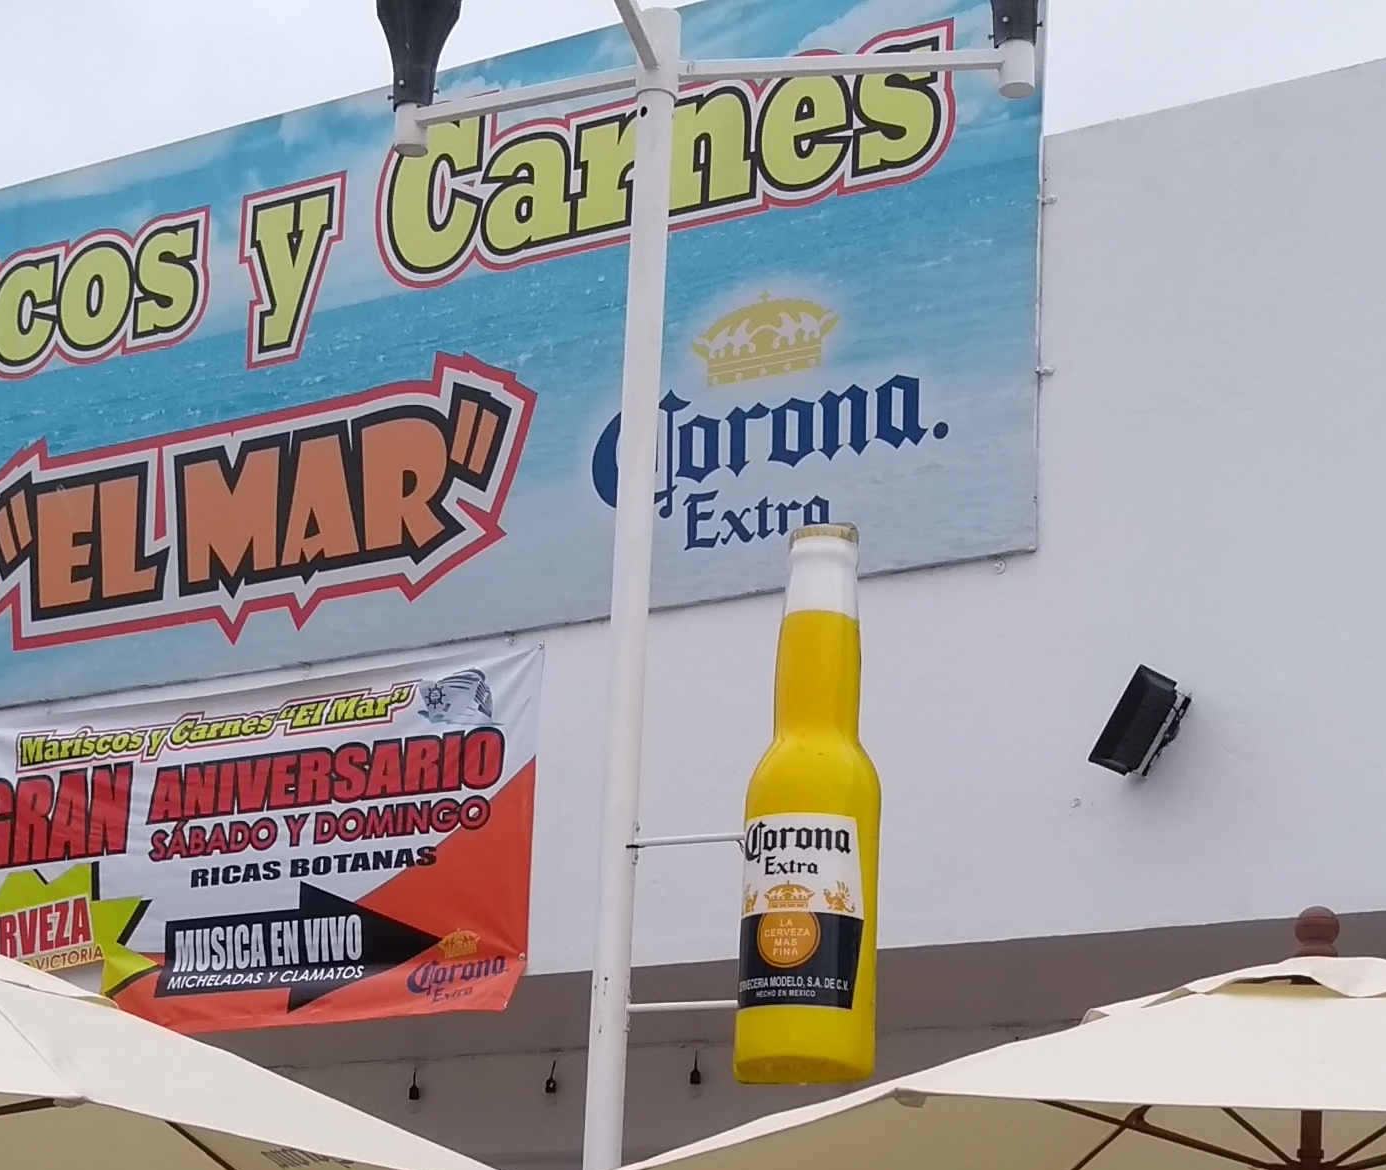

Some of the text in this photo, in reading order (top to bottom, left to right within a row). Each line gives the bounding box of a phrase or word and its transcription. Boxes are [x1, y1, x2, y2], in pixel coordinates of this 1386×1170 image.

[245, 185, 336, 356] y
[386, 36, 942, 275] Carnes
[683, 490, 832, 552] Extra
[20, 729, 146, 767] Mariscos
[146, 727, 171, 757] y
[170, 711, 277, 746] Carnes
[145, 726, 506, 826] ANIVERSARIO
[284, 812, 310, 847] Y
[313, 795, 492, 846] DOMINGO
[745, 820, 852, 864] Corona
[190, 846, 438, 888] RICAS BOTANAS
[764, 855, 820, 876] Extra
[172, 914, 363, 973] MUSICA EN VIVO
[764, 928, 811, 938] CERVEZA
[779, 918, 793, 928] LA
[36, 946, 104, 971] VICTORIA
[773, 947, 799, 956] FINA
[166, 965, 365, 990] MICHELADAS Y CLAMATOS
[824, 977, 835, 990] DE
